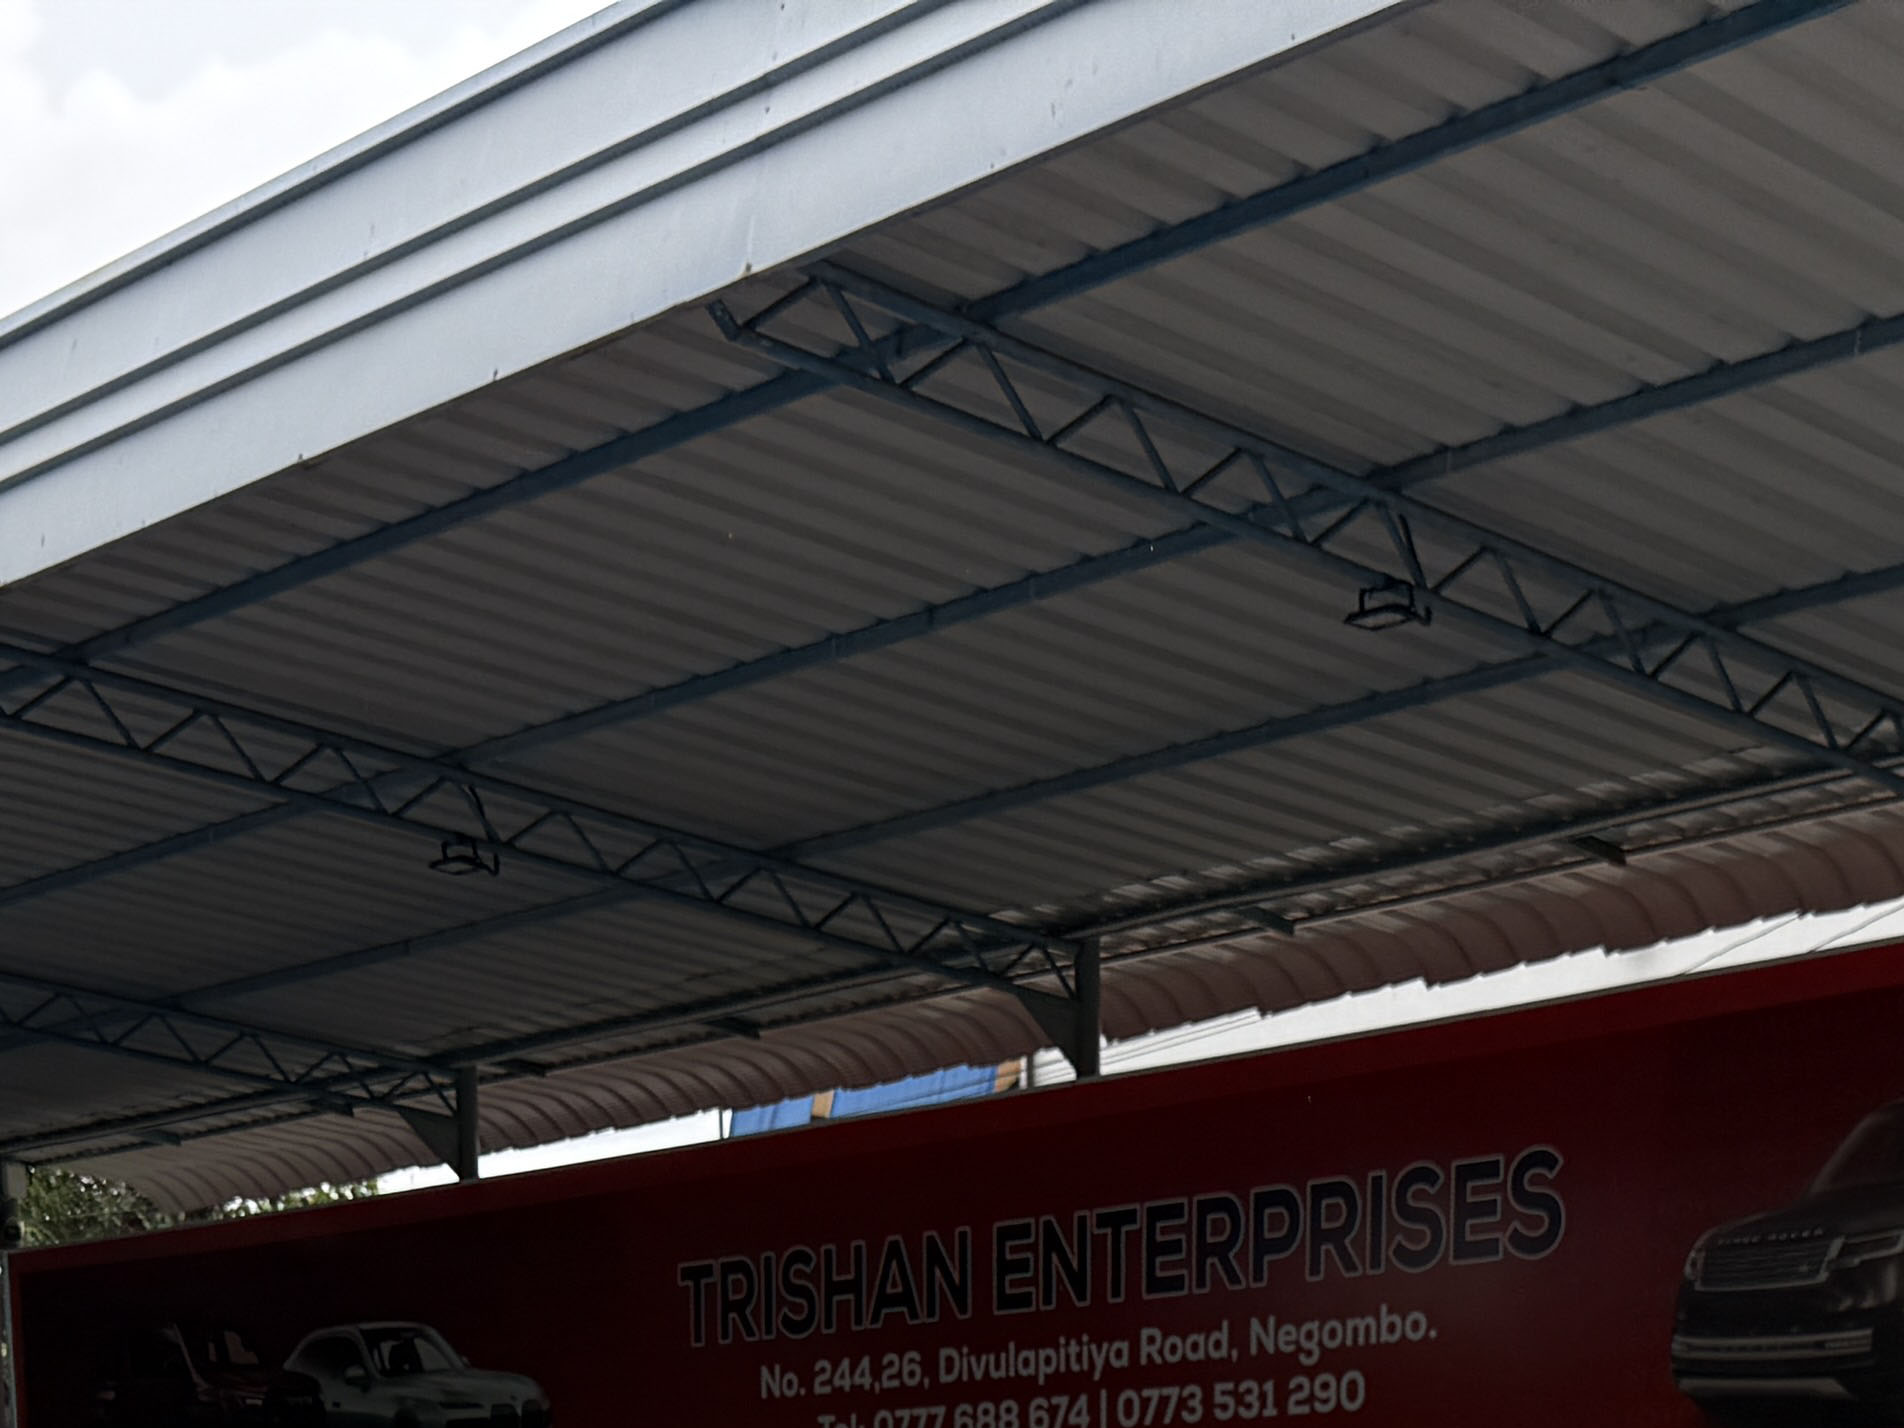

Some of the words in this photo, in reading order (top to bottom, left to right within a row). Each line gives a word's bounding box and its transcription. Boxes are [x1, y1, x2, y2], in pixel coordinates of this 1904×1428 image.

[676, 1224, 973, 1349] TRISHAN
[992, 1143, 1566, 1317] ENTERPRISES
[759, 1363, 806, 1400] No.
[938, 1332, 1130, 1387] Divulapitiya
[1139, 1319, 1239, 1369] Road,
[1249, 1303, 1438, 1368] Negombo.
[1211, 1378, 1279, 1422] 531
[1286, 1368, 1366, 1417] 290
